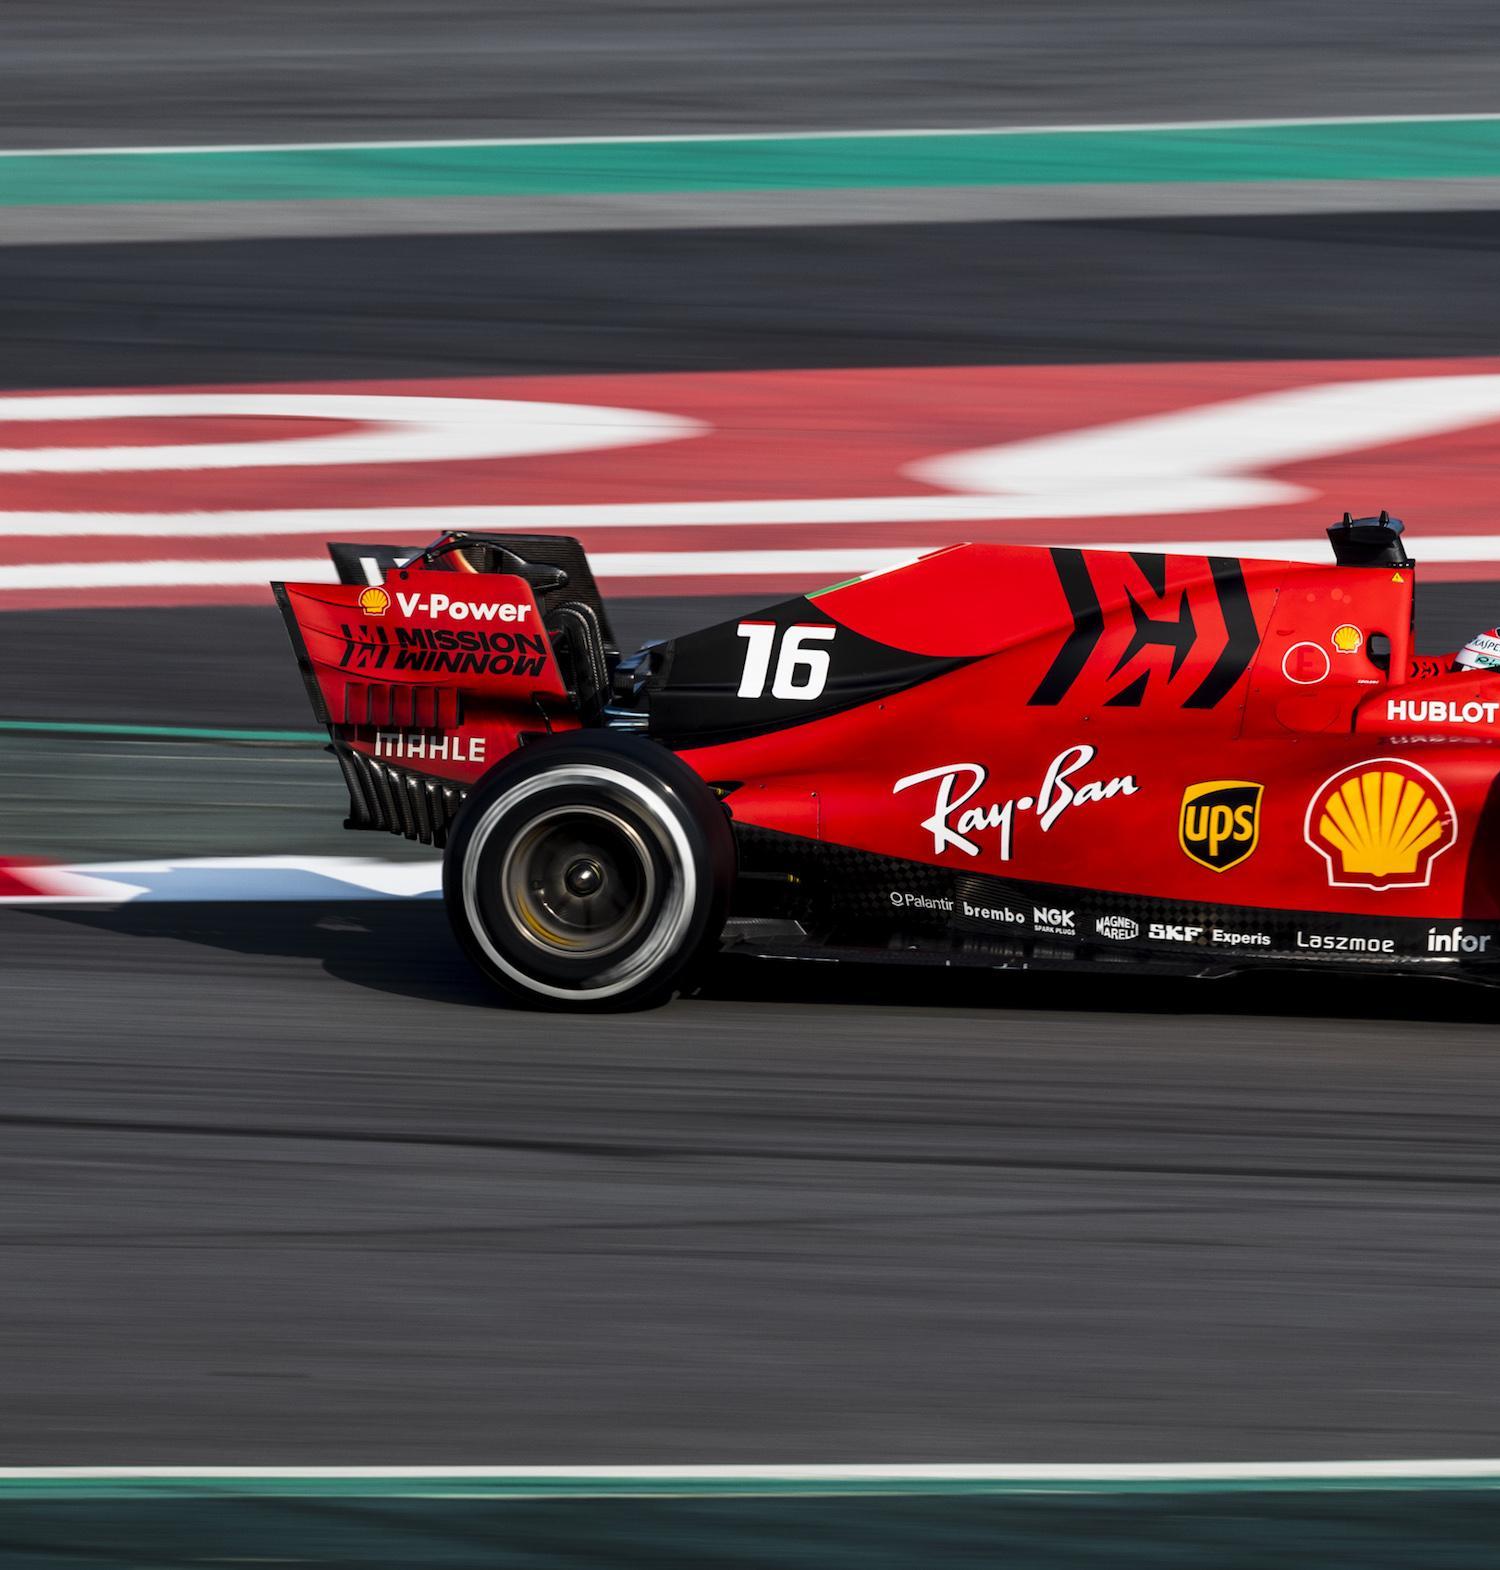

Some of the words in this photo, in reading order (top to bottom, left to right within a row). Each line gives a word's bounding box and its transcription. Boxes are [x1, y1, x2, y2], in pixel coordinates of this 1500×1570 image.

[395, 592, 531, 622] V-Power
[393, 626, 547, 655] MISSION
[393, 650, 546, 677] WINNOW
[736, 620, 837, 700] 16
[1387, 700, 1499, 723] HUBLOT
[374, 731, 486, 762] MAHLE
[1185, 803, 1254, 857] ups
[905, 893, 954, 912] Palantir
[963, 902, 1026, 924] brembo
[1033, 907, 1075, 928] NGK
[1034, 925, 1054, 934] SPARK
[1055, 927, 1076, 936] PLUGS
[1148, 923, 1204, 942] SKF
[1212, 929, 1271, 946] Experis
[1296, 931, 1395, 953] Laszmoe
[1427, 926, 1491, 952] infor
